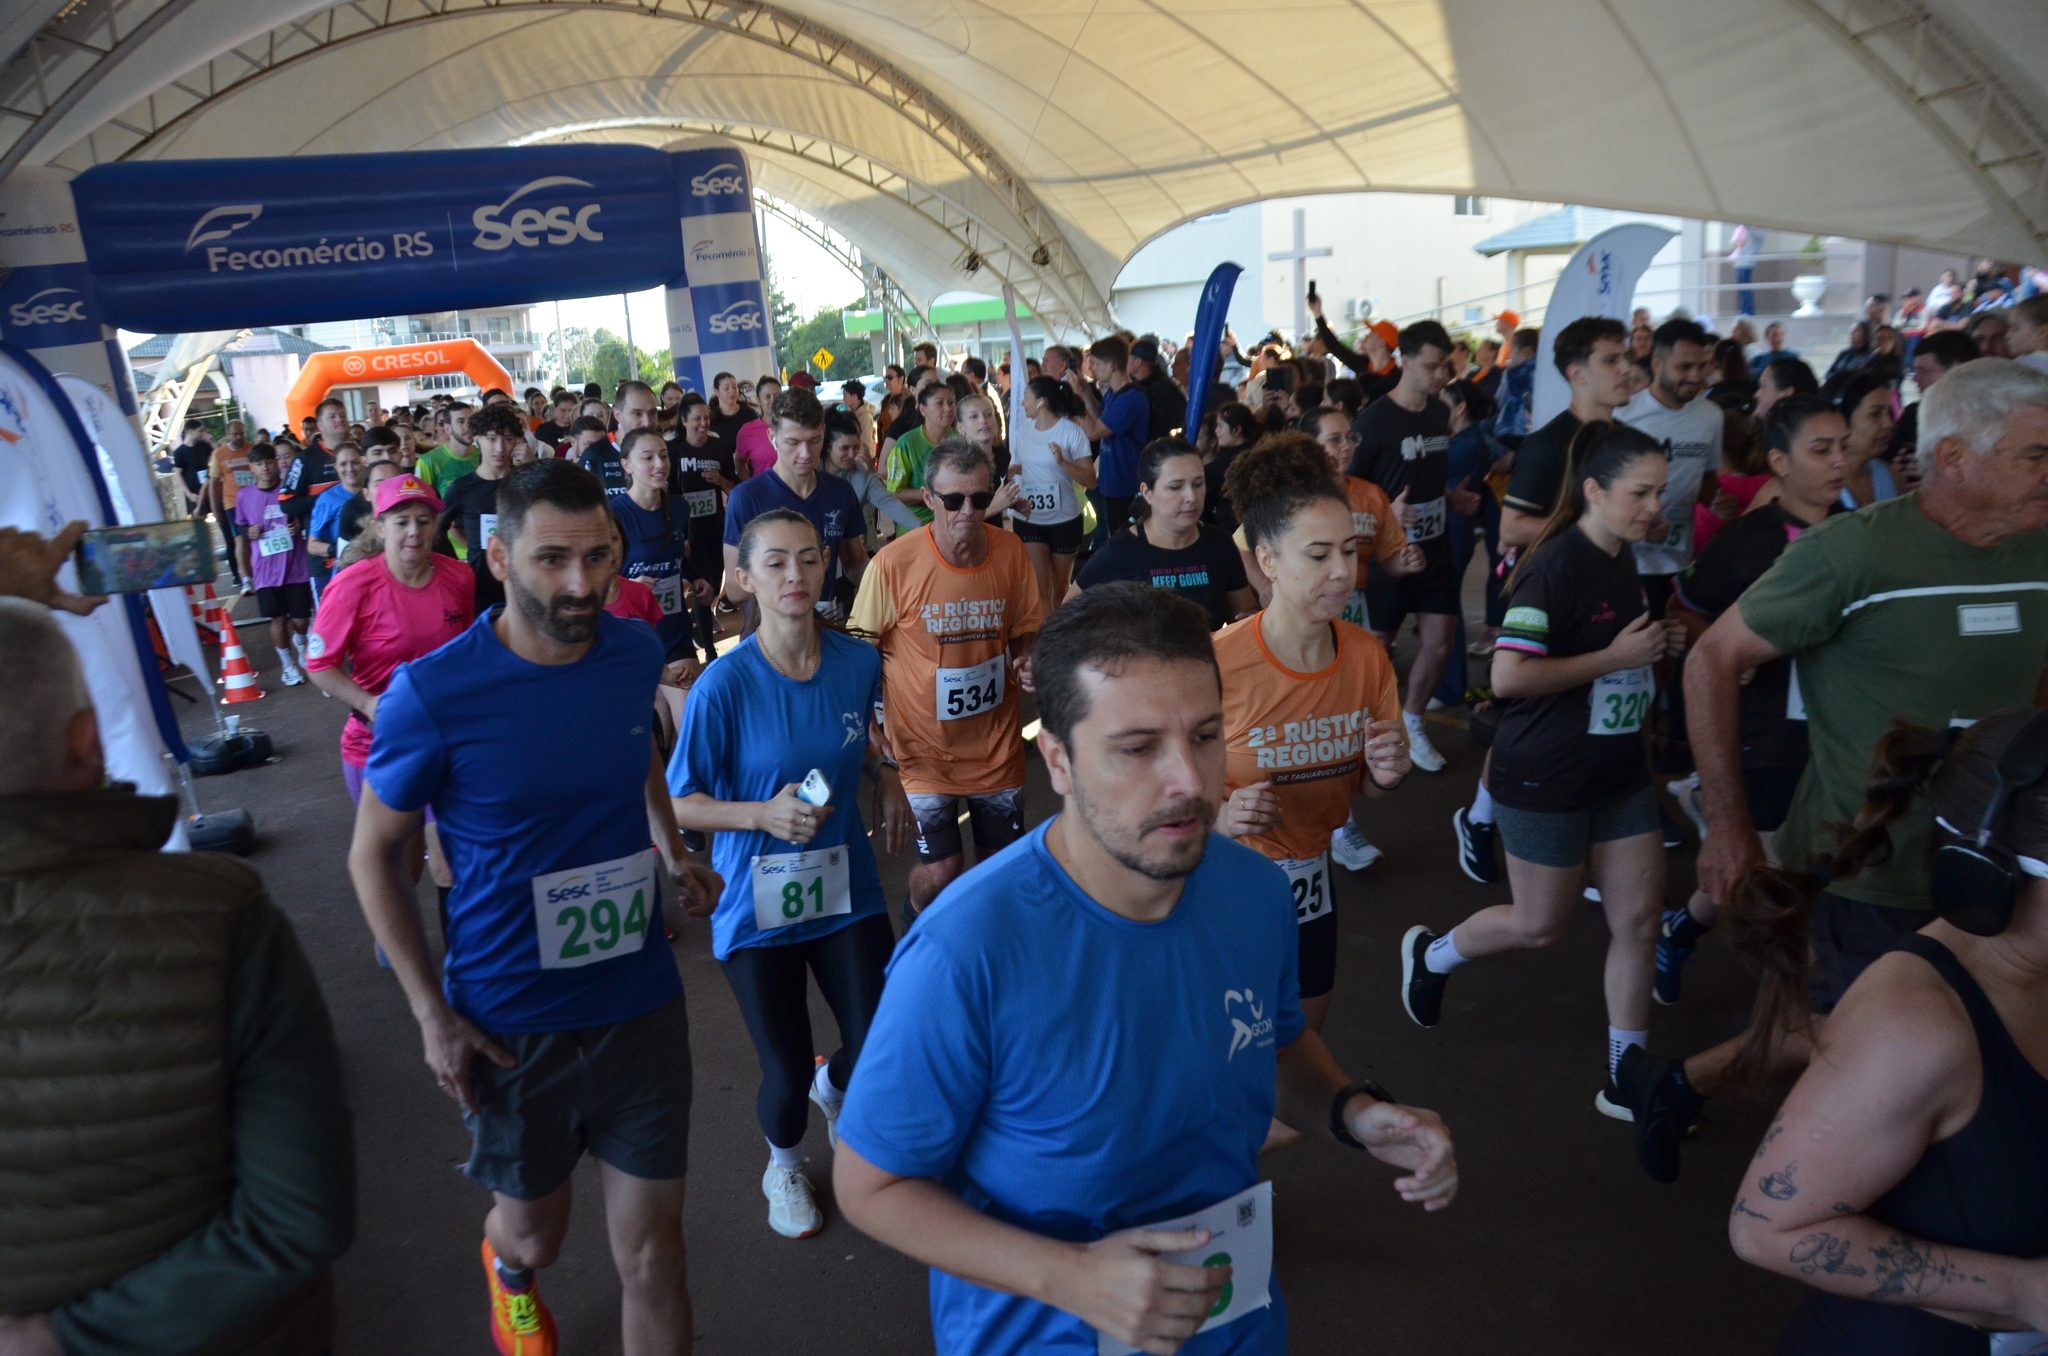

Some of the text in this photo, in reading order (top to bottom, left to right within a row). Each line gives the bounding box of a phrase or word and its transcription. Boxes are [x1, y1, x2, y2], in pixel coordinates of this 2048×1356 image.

[59, 222, 75, 233] RS
[207, 231, 434, 273] Fecomércio RS
[696, 247, 747, 261] Fecomércio
[372, 350, 451, 371] CRESOL
[264, 538, 290, 552] 169
[1152, 571, 1209, 588] KEEP GOING
[927, 614, 1004, 633] REGIONAL
[947, 677, 998, 716] 534
[1601, 690, 1650, 729] 320
[1248, 726, 1278, 748] 2ª
[782, 876, 823, 919] 81
[1291, 869, 1323, 917] 25
[556, 888, 648, 960] 294
